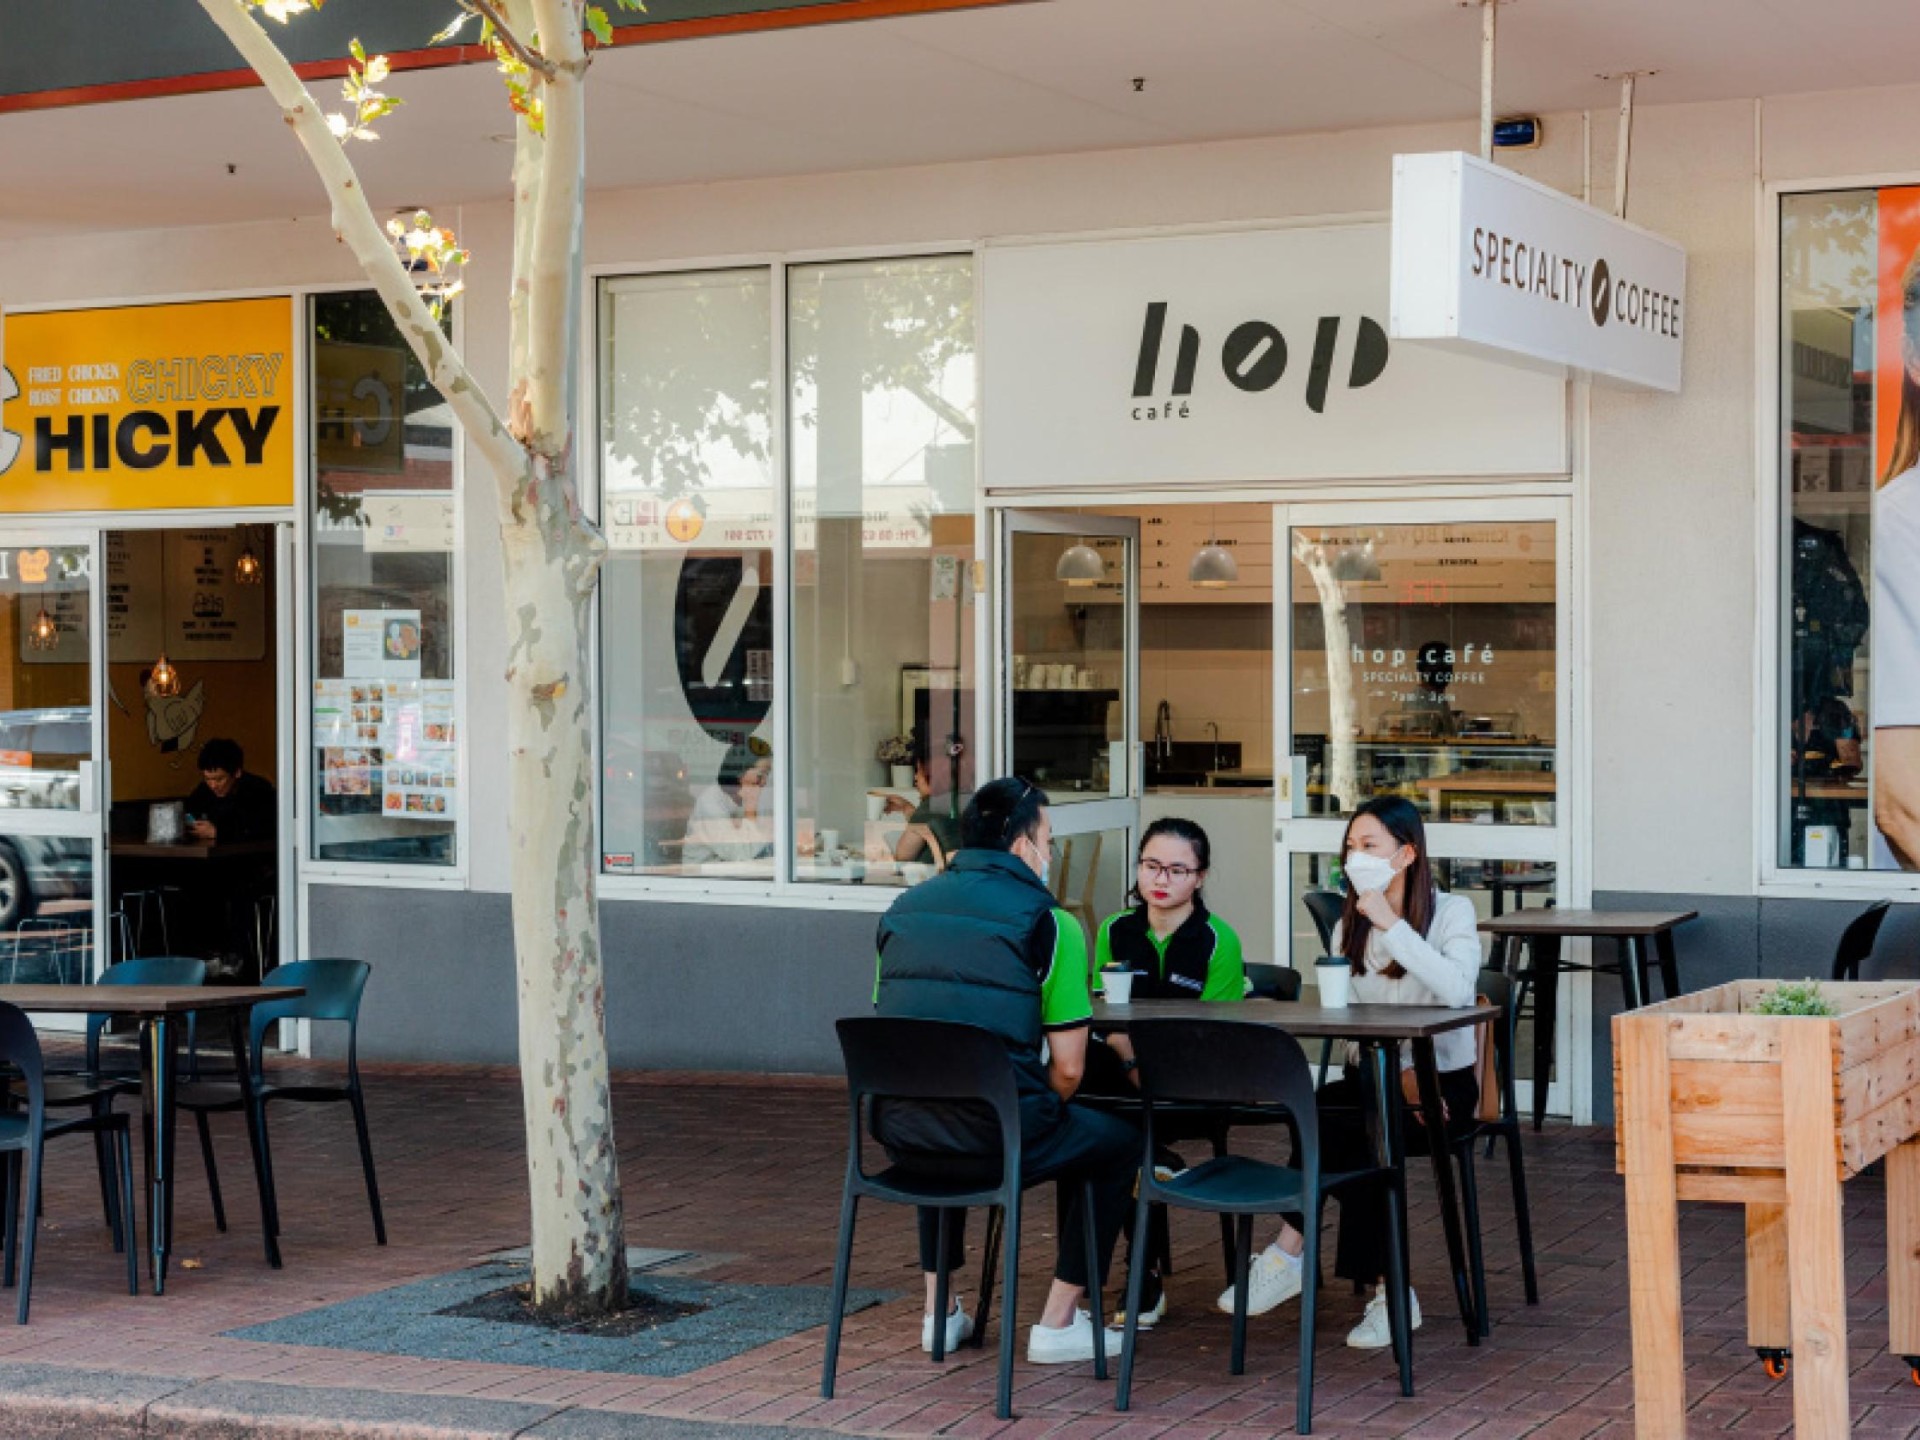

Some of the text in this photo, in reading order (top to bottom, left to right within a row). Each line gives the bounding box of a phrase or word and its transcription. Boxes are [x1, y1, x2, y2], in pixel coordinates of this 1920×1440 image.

[1472, 227, 1679, 338] SPECIALTY COFFEE
[1131, 302, 1389, 413] hop
[29, 364, 120, 384] FRIED CHICKEN
[127, 353, 284, 403] CHICKY
[68, 387, 120, 403] CHICKEN
[1131, 401, 1190, 421] café
[1352, 643, 1494, 668] hop café
[1362, 672, 1485, 684] SPECIALTY COFFEE
